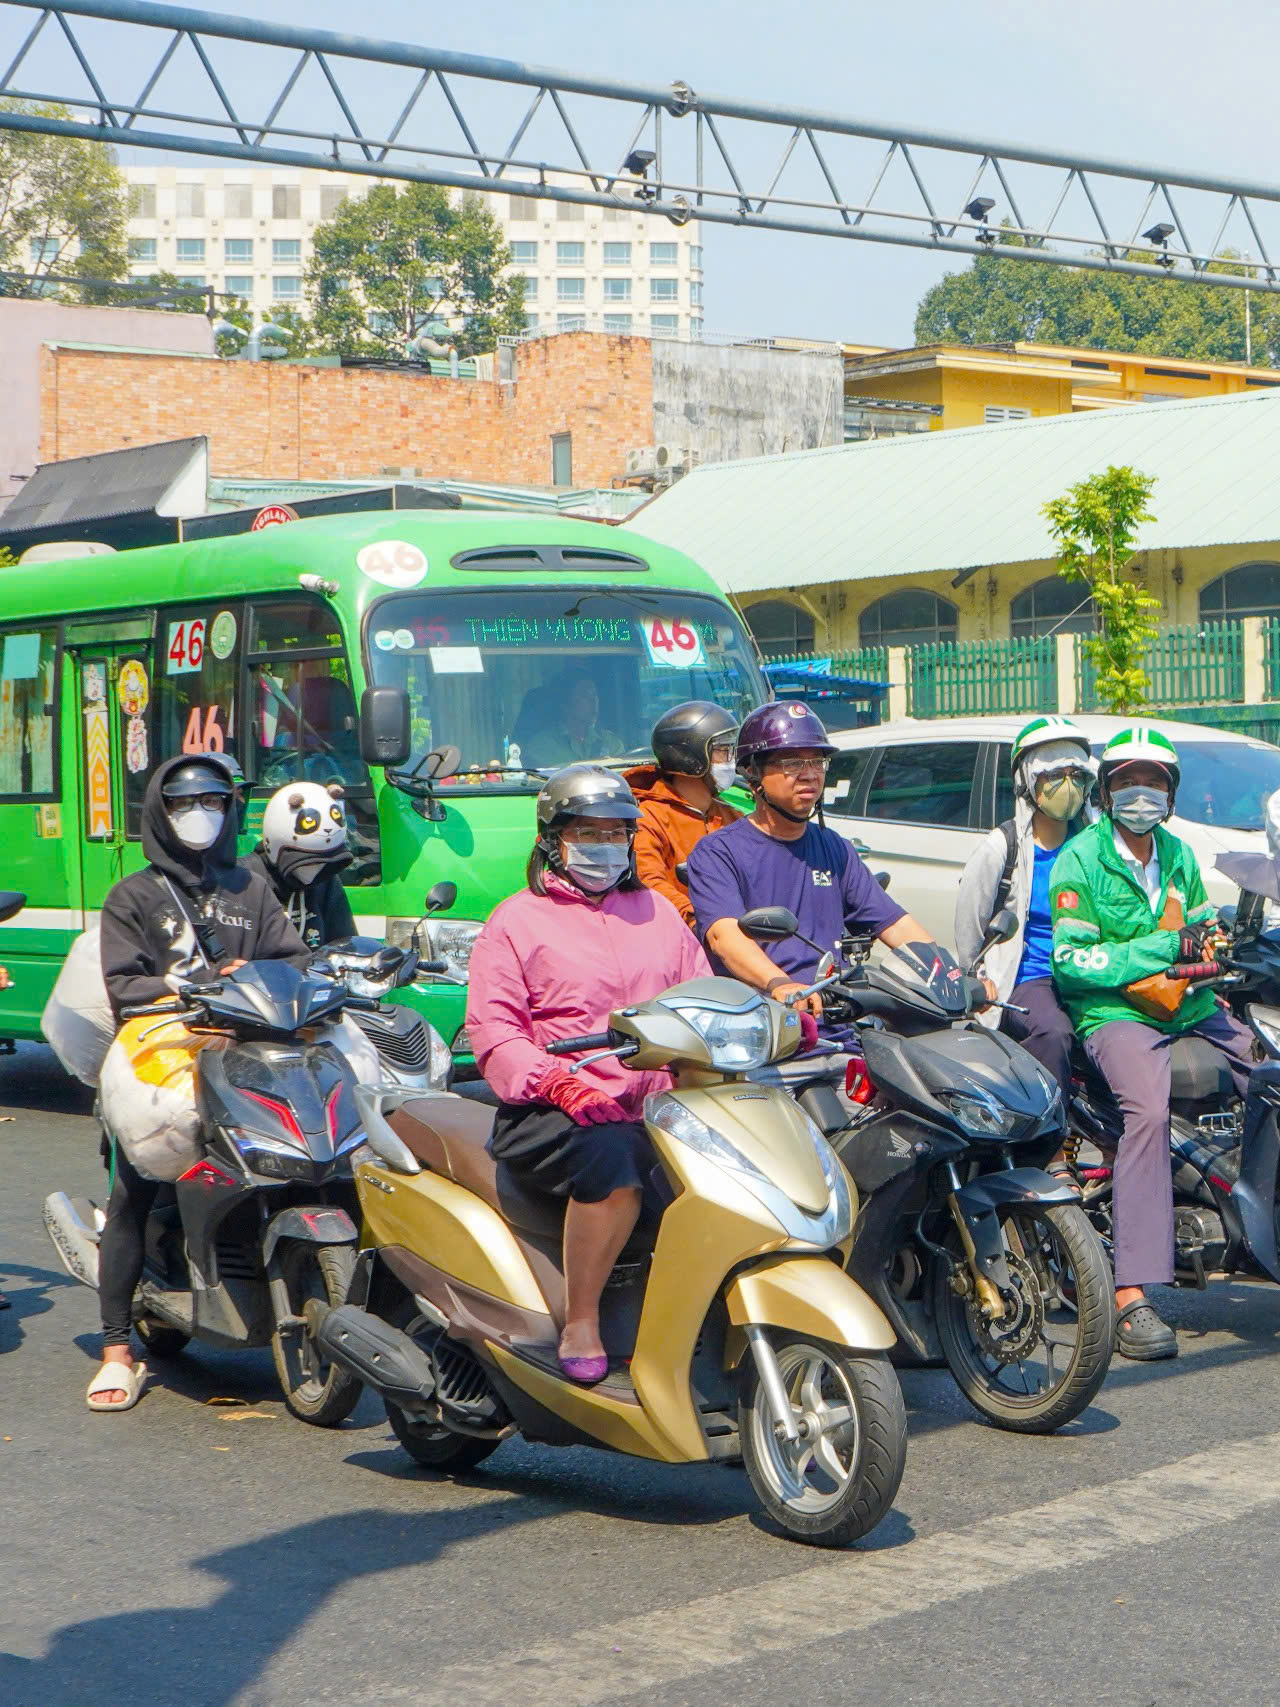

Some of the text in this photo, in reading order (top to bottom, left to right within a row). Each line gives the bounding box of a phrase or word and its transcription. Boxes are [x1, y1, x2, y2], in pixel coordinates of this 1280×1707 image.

[169, 620, 204, 668] 46
[651, 618, 697, 652] 46
[182, 704, 224, 755] 46
[1054, 944, 1109, 970] Gab
[887, 1151, 912, 1159] HONDA
